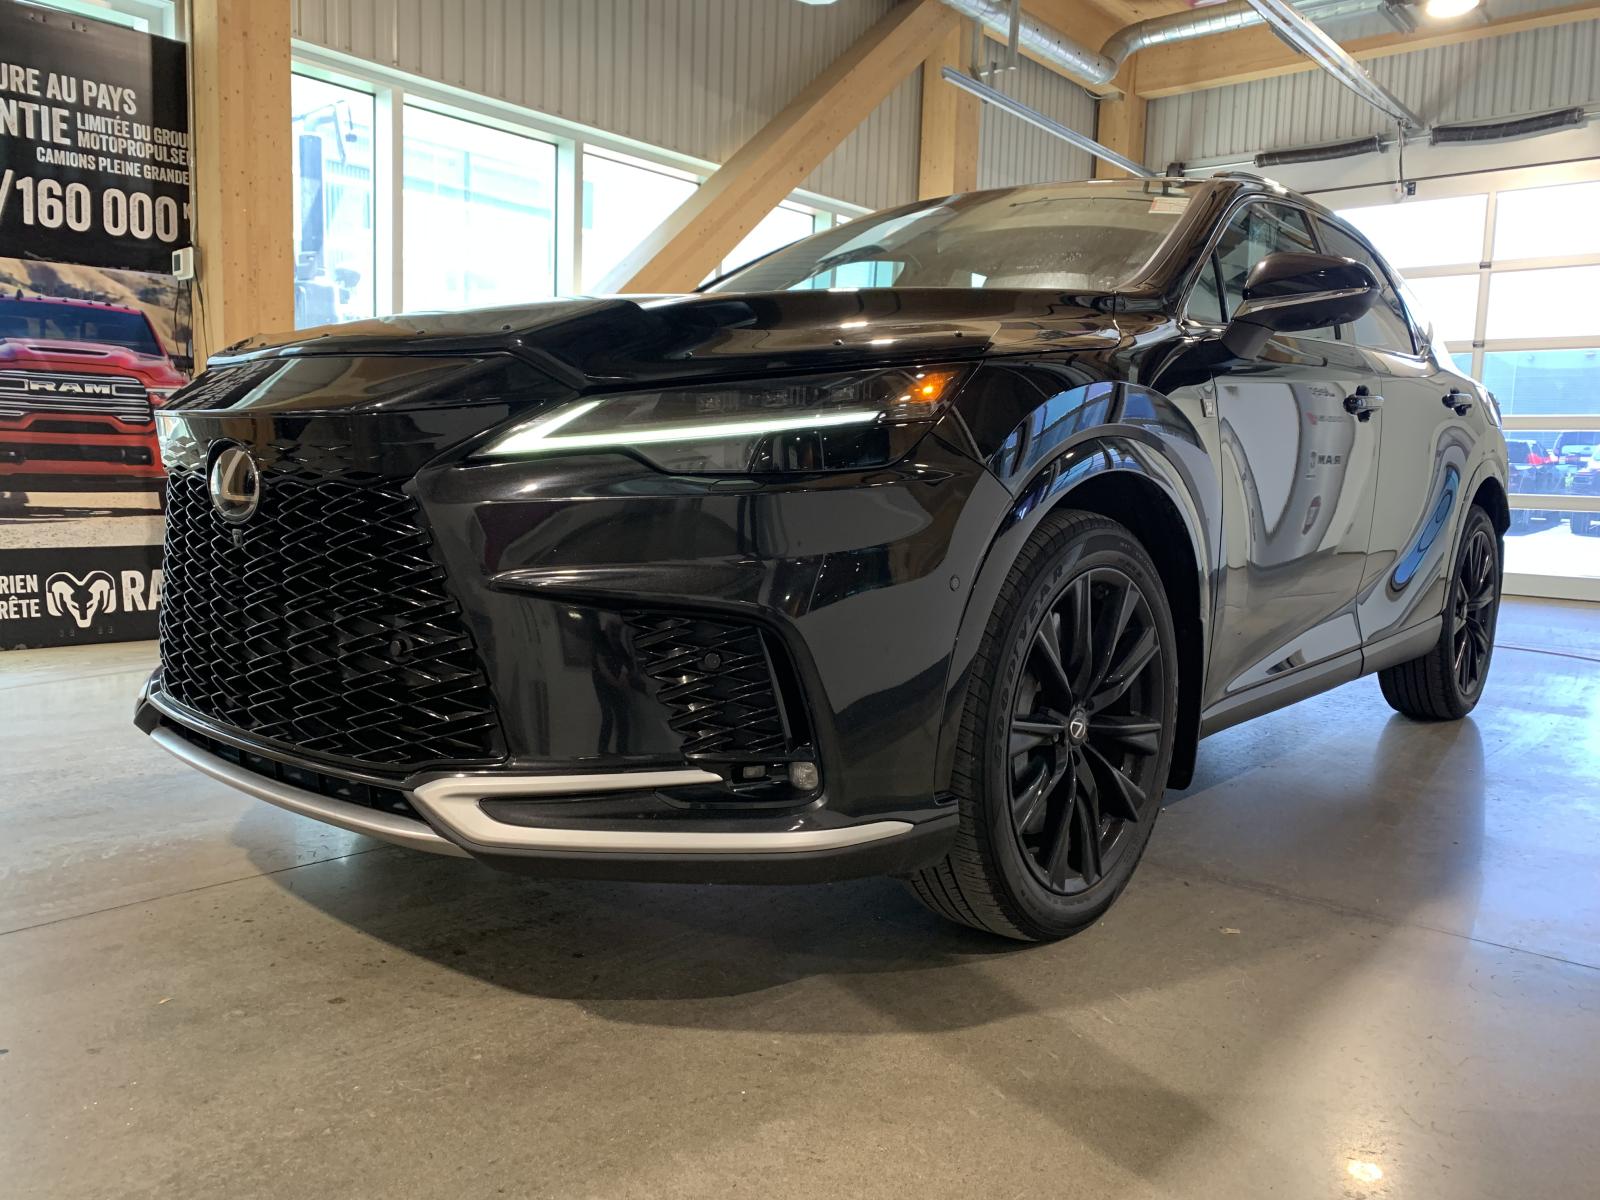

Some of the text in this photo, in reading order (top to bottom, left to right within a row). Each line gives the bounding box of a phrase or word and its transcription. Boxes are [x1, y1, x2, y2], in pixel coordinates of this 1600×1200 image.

[47, 73, 76, 103] AU
[83, 80, 136, 115] PAYS
[77, 112, 130, 138] LIMITÉE
[133, 123, 150, 141] DU
[37, 147, 96, 171] CAMIONS
[98, 157, 141, 178] PLEINE
[103, 187, 179, 243] 000
[30, 380, 111, 394] RAM
